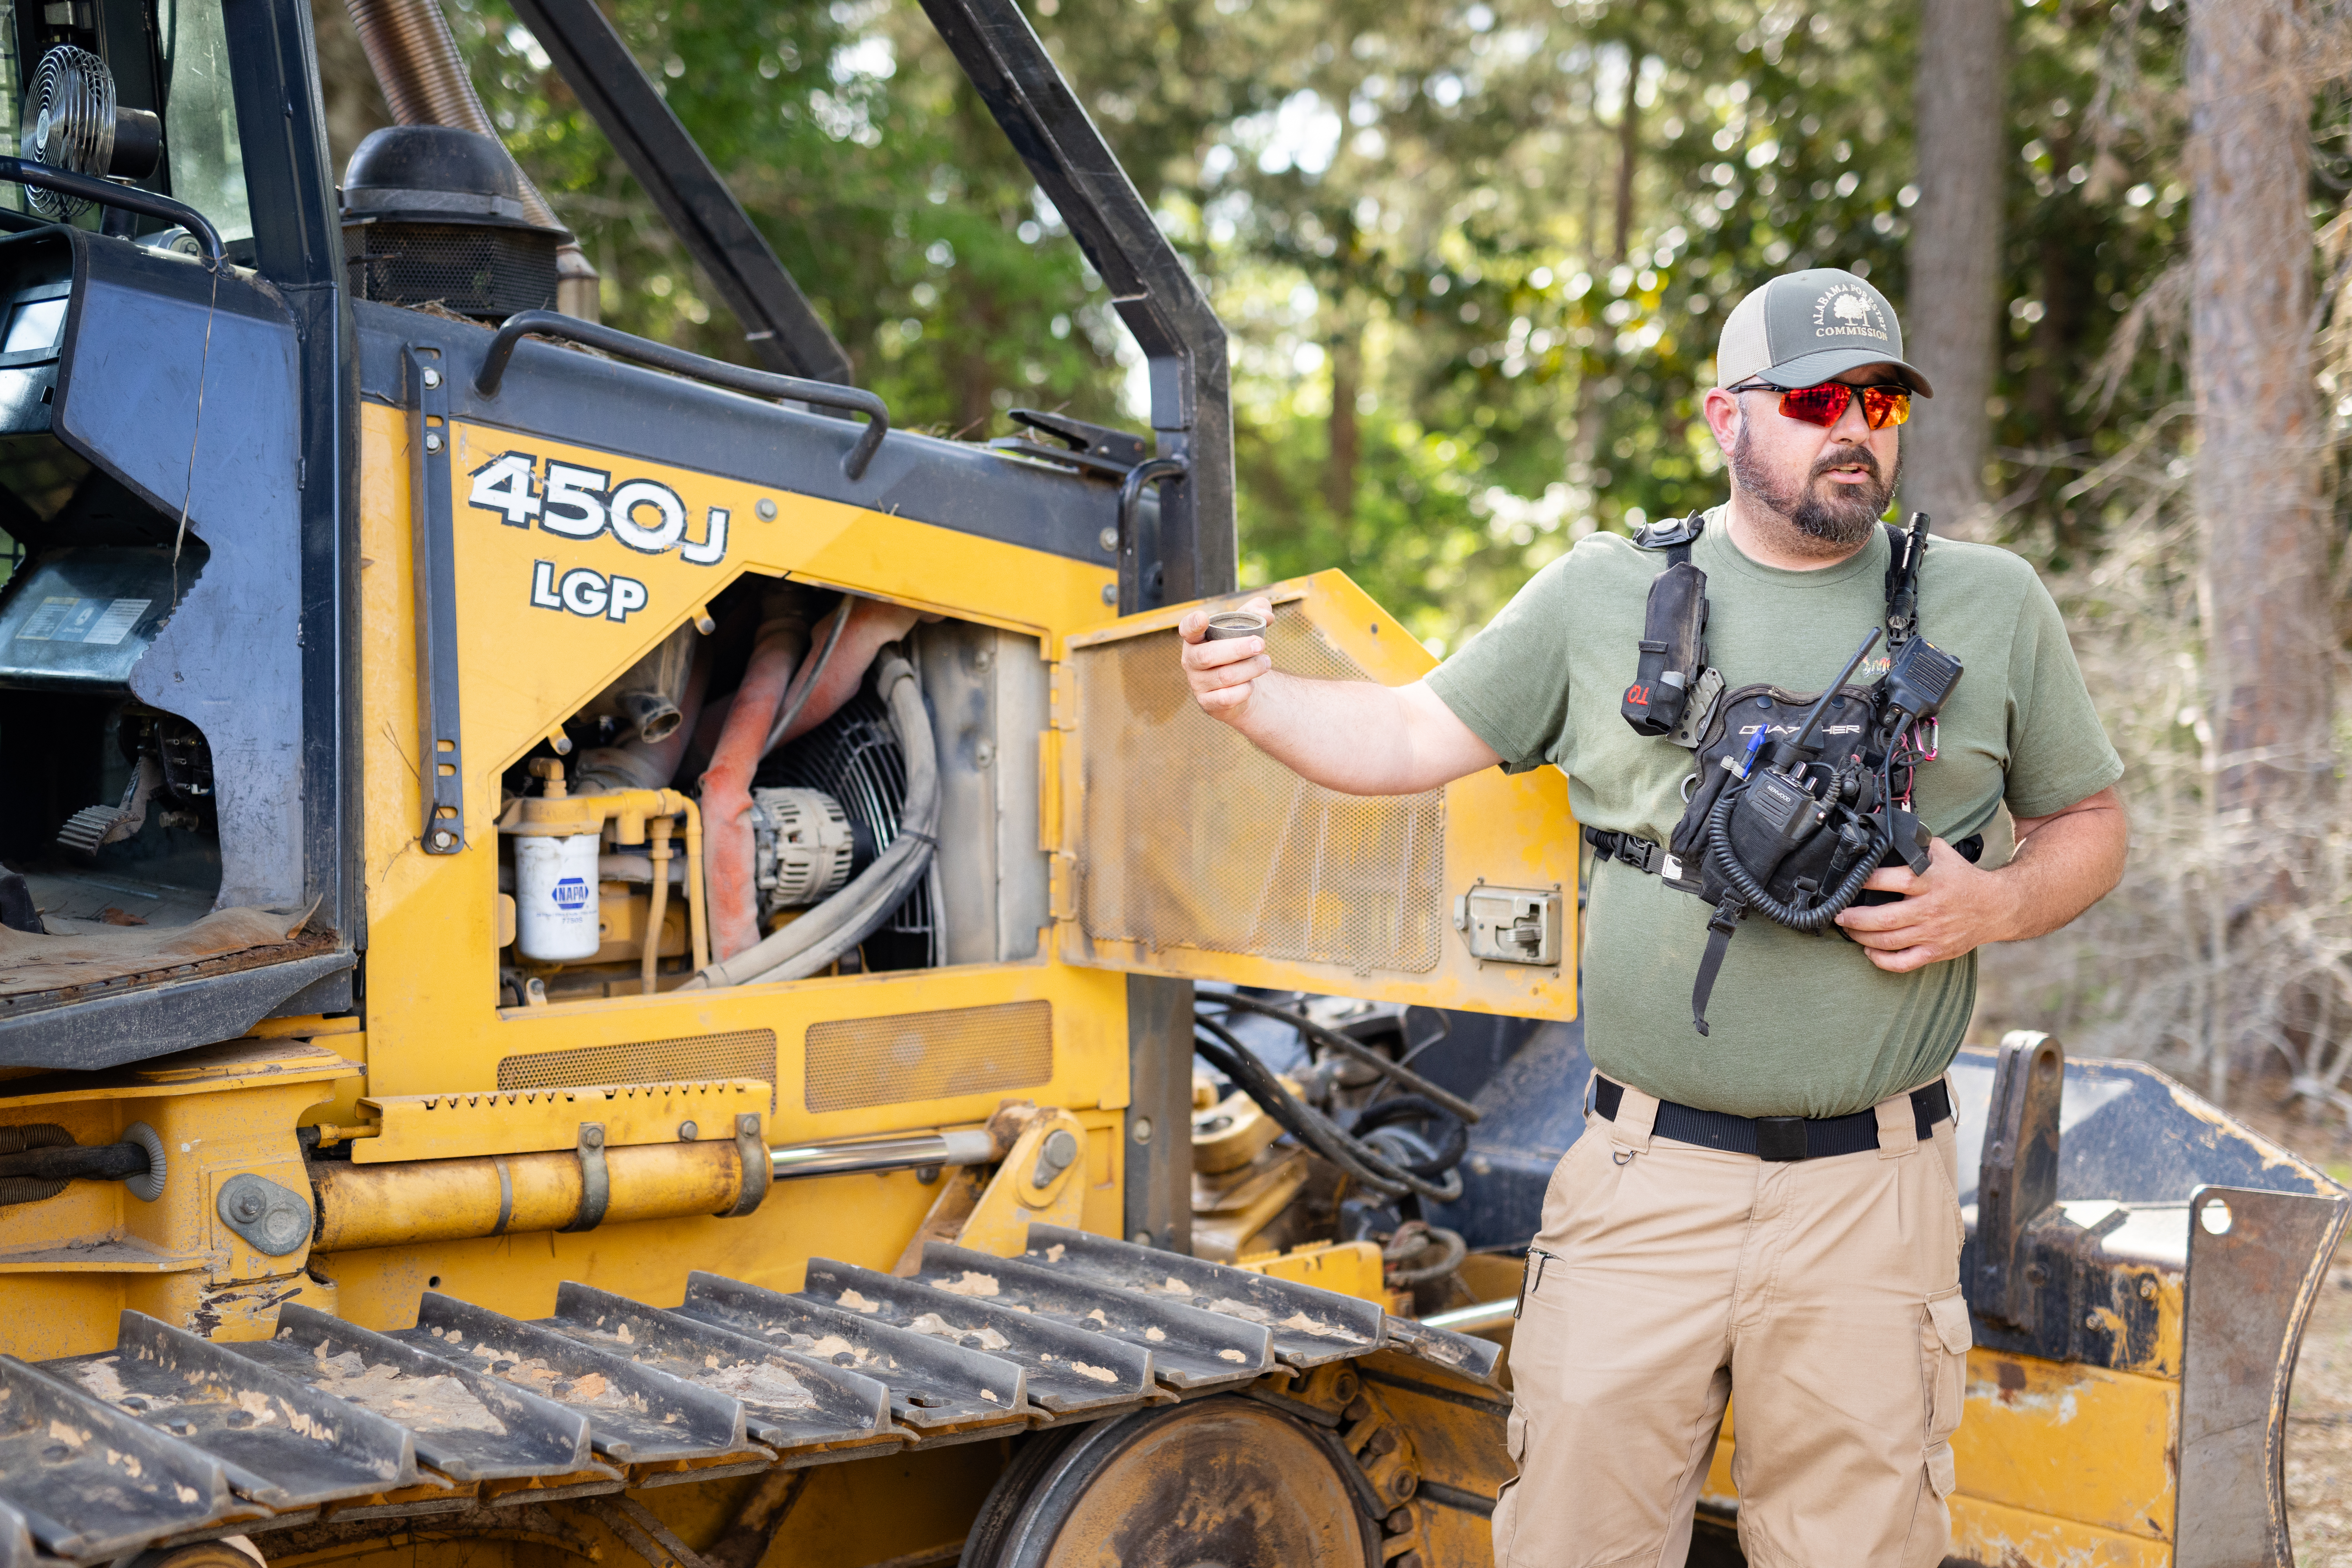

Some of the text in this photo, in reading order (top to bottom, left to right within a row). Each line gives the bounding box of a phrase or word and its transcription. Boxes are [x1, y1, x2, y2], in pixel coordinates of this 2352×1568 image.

[1813, 283, 1887, 331] ALABAMA FORESTRY
[1816, 326, 1888, 341] COMMISSION
[468, 450, 730, 566] 450J
[530, 559, 648, 623] LGP
[1767, 785, 1791, 802] KENWOOD
[559, 886, 584, 901] NAPA
